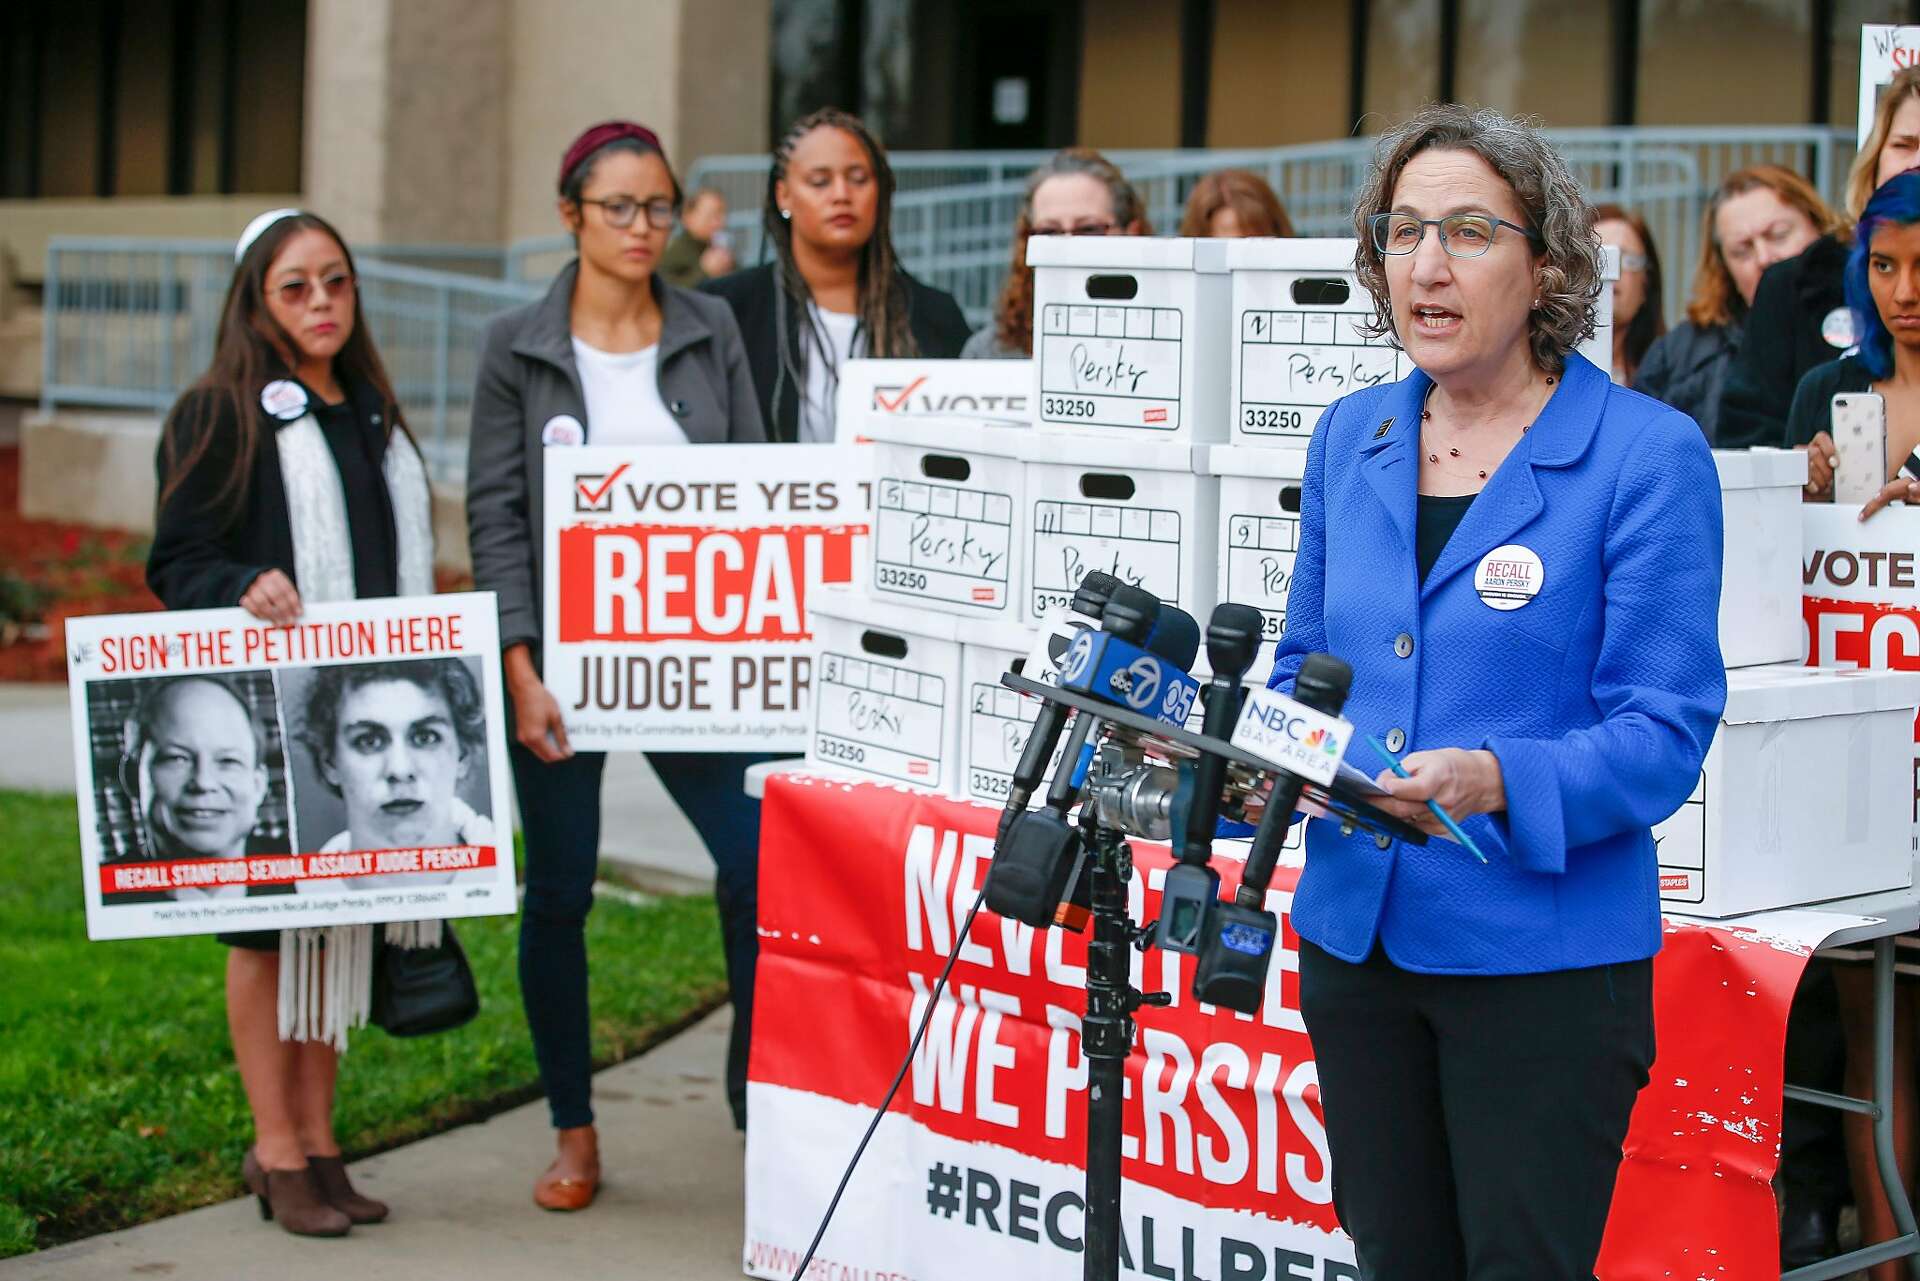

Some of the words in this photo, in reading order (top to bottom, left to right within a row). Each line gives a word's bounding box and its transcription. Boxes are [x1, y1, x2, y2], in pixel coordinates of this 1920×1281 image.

[1045, 398, 1095, 418] 33250
[1245, 410, 1301, 428] 33250
[626, 483, 737, 511] VOTE
[757, 482, 839, 511] YES
[1238, 525, 1249, 545] 9
[880, 568, 927, 590] 33250
[1486, 562, 1533, 580] RECALL
[1803, 550, 1914, 587] VOTE
[101, 633, 168, 673] SIGN
[176, 630, 233, 668] THE
[244, 621, 375, 663] PETITION
[387, 615, 463, 654] HERE
[574, 656, 711, 711] JUDGE
[732, 656, 811, 711] PER
[1247, 700, 1306, 741] NBC
[820, 739, 865, 763] 33250
[1240, 725, 1277, 747] BAY
[1281, 744, 1331, 772] AREA
[974, 774, 1009, 795] 3325
[114, 865, 171, 889] RECALL
[171, 860, 249, 886] STANFORD
[250, 857, 307, 881] SEXUAL
[308, 852, 373, 878] ASSAULT
[375, 850, 421, 873] JUDGE
[421, 847, 480, 870] PERSKY
[1660, 878, 1688, 887] STAPLES
[908, 973, 1020, 1128] WE
